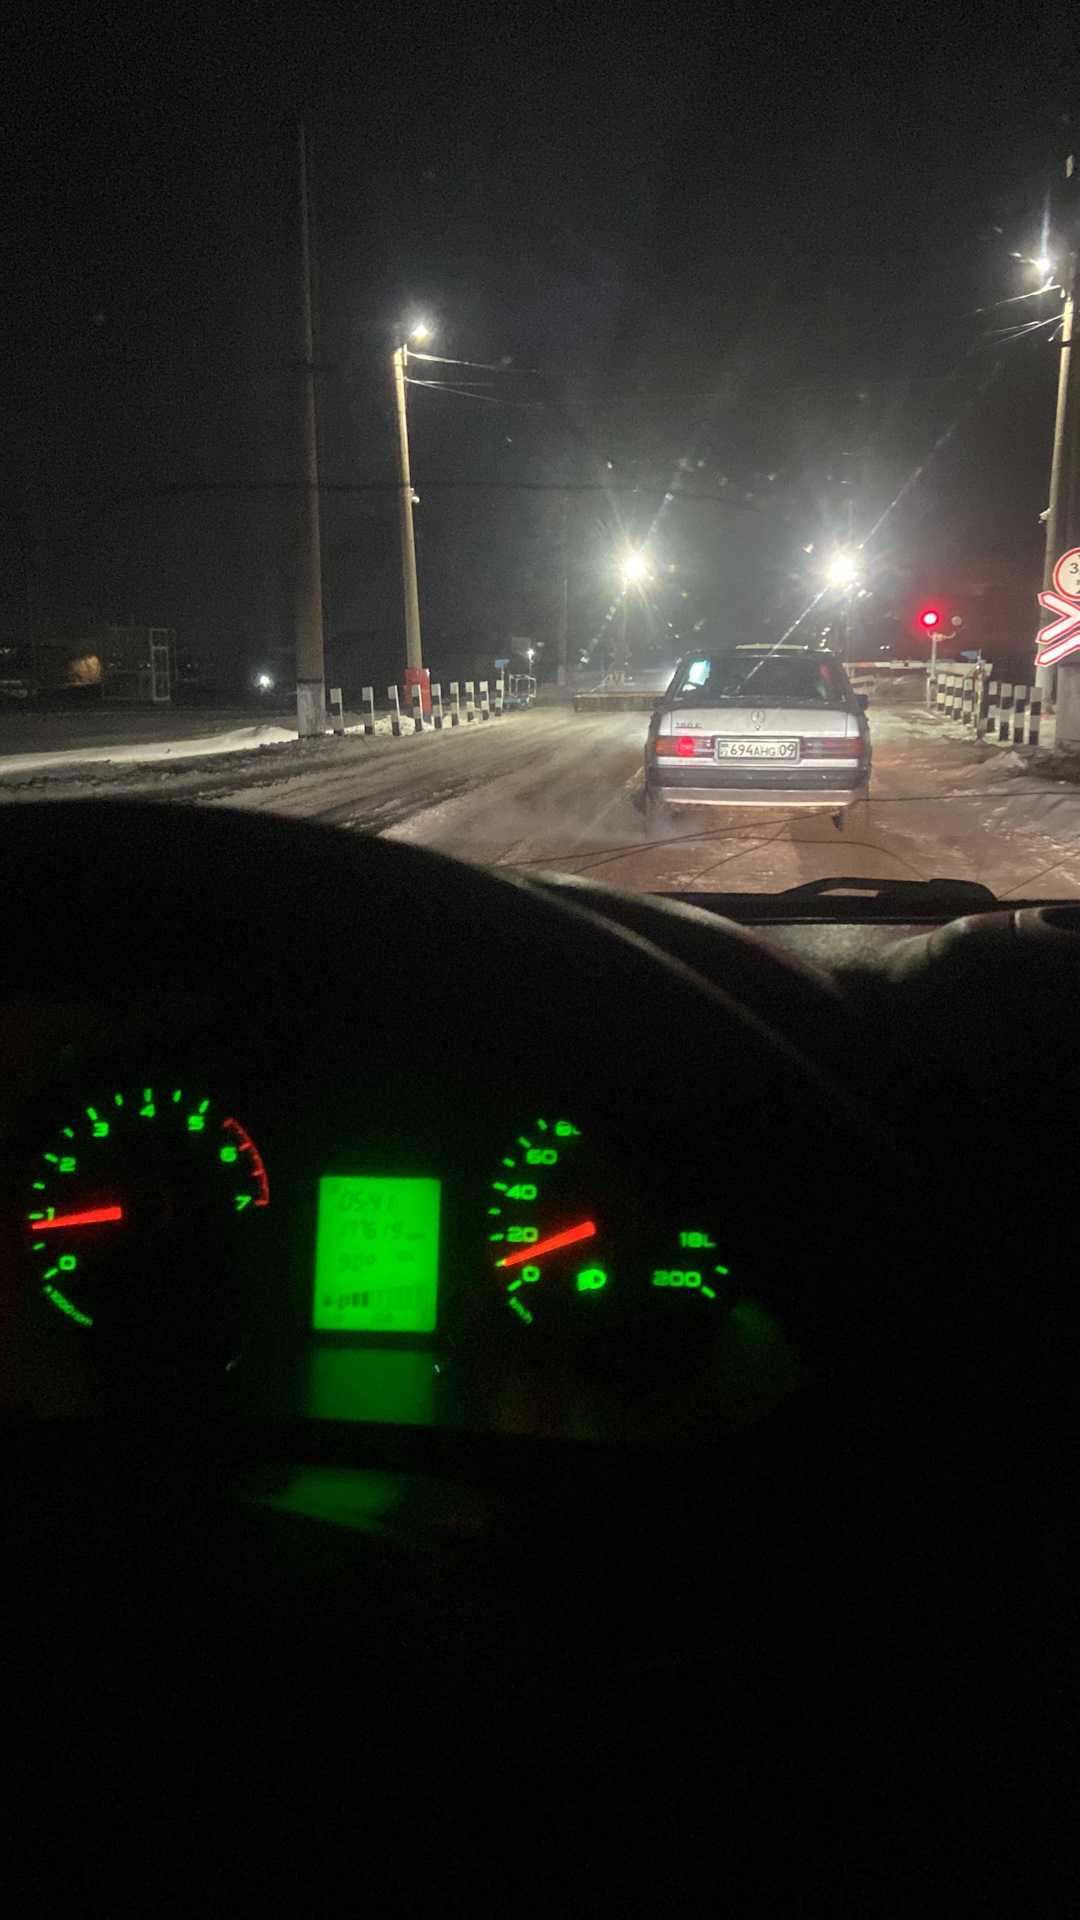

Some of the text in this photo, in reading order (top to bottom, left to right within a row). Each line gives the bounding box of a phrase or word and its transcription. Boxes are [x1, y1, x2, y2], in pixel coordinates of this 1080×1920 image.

[730, 744, 776, 757] 694AHG
[779, 744, 796, 757] 09
[140, 1103, 155, 1118] 4
[93, 1122, 109, 1137] 3
[188, 1115, 204, 1130] 5
[554, 1121, 581, 1136] 8
[219, 1146, 237, 1162] 6
[525, 1149, 558, 1165] 60
[59, 1157, 76, 1172] 2
[505, 1184, 537, 1200] 40
[235, 1195, 251, 1211] 7
[46, 1207, 55, 1221] 1
[506, 1226, 539, 1243] 20
[679, 1231, 717, 1247] 18
[58, 1255, 76, 1270] 0
[521, 1265, 540, 1282] 0
[652, 1270, 702, 1288] 200
